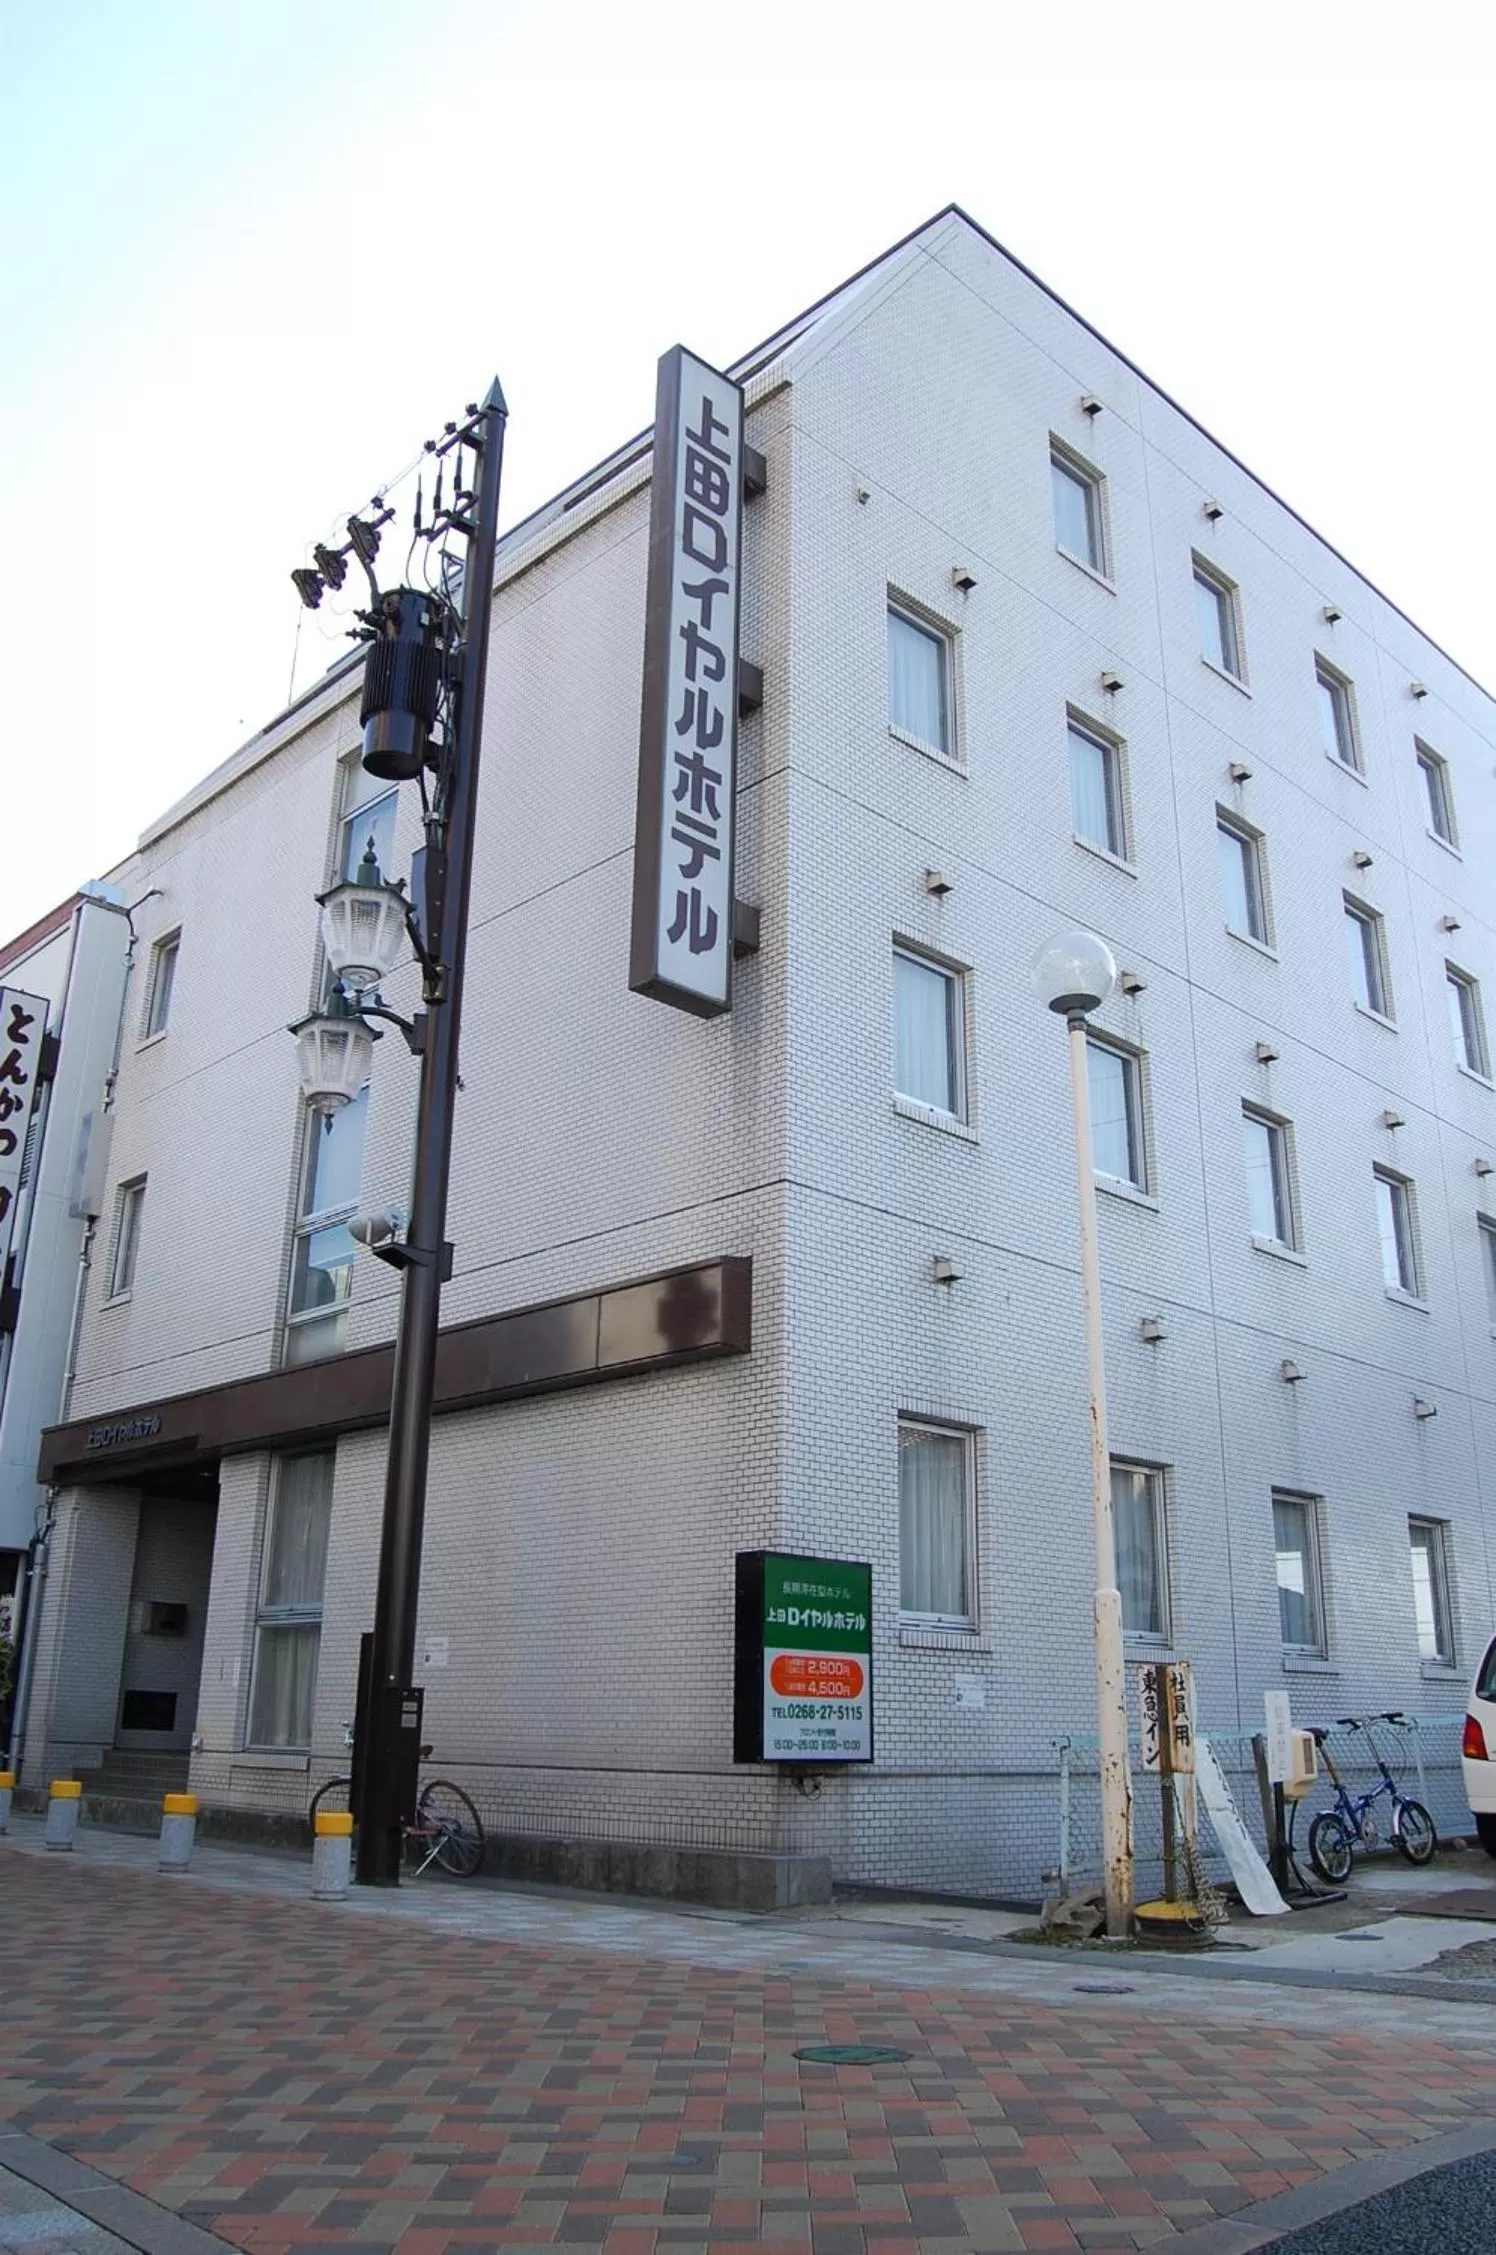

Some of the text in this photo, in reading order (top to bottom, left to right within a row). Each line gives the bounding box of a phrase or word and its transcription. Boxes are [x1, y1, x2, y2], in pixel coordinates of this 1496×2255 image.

[666, 395, 731, 955] 上田ロイヤルホテル
[767, 1607, 866, 1631] 上田ロイヤルホテル
[1141, 1670, 1159, 1765] 東急イン
[1170, 1671, 1190, 1746] 社員用
